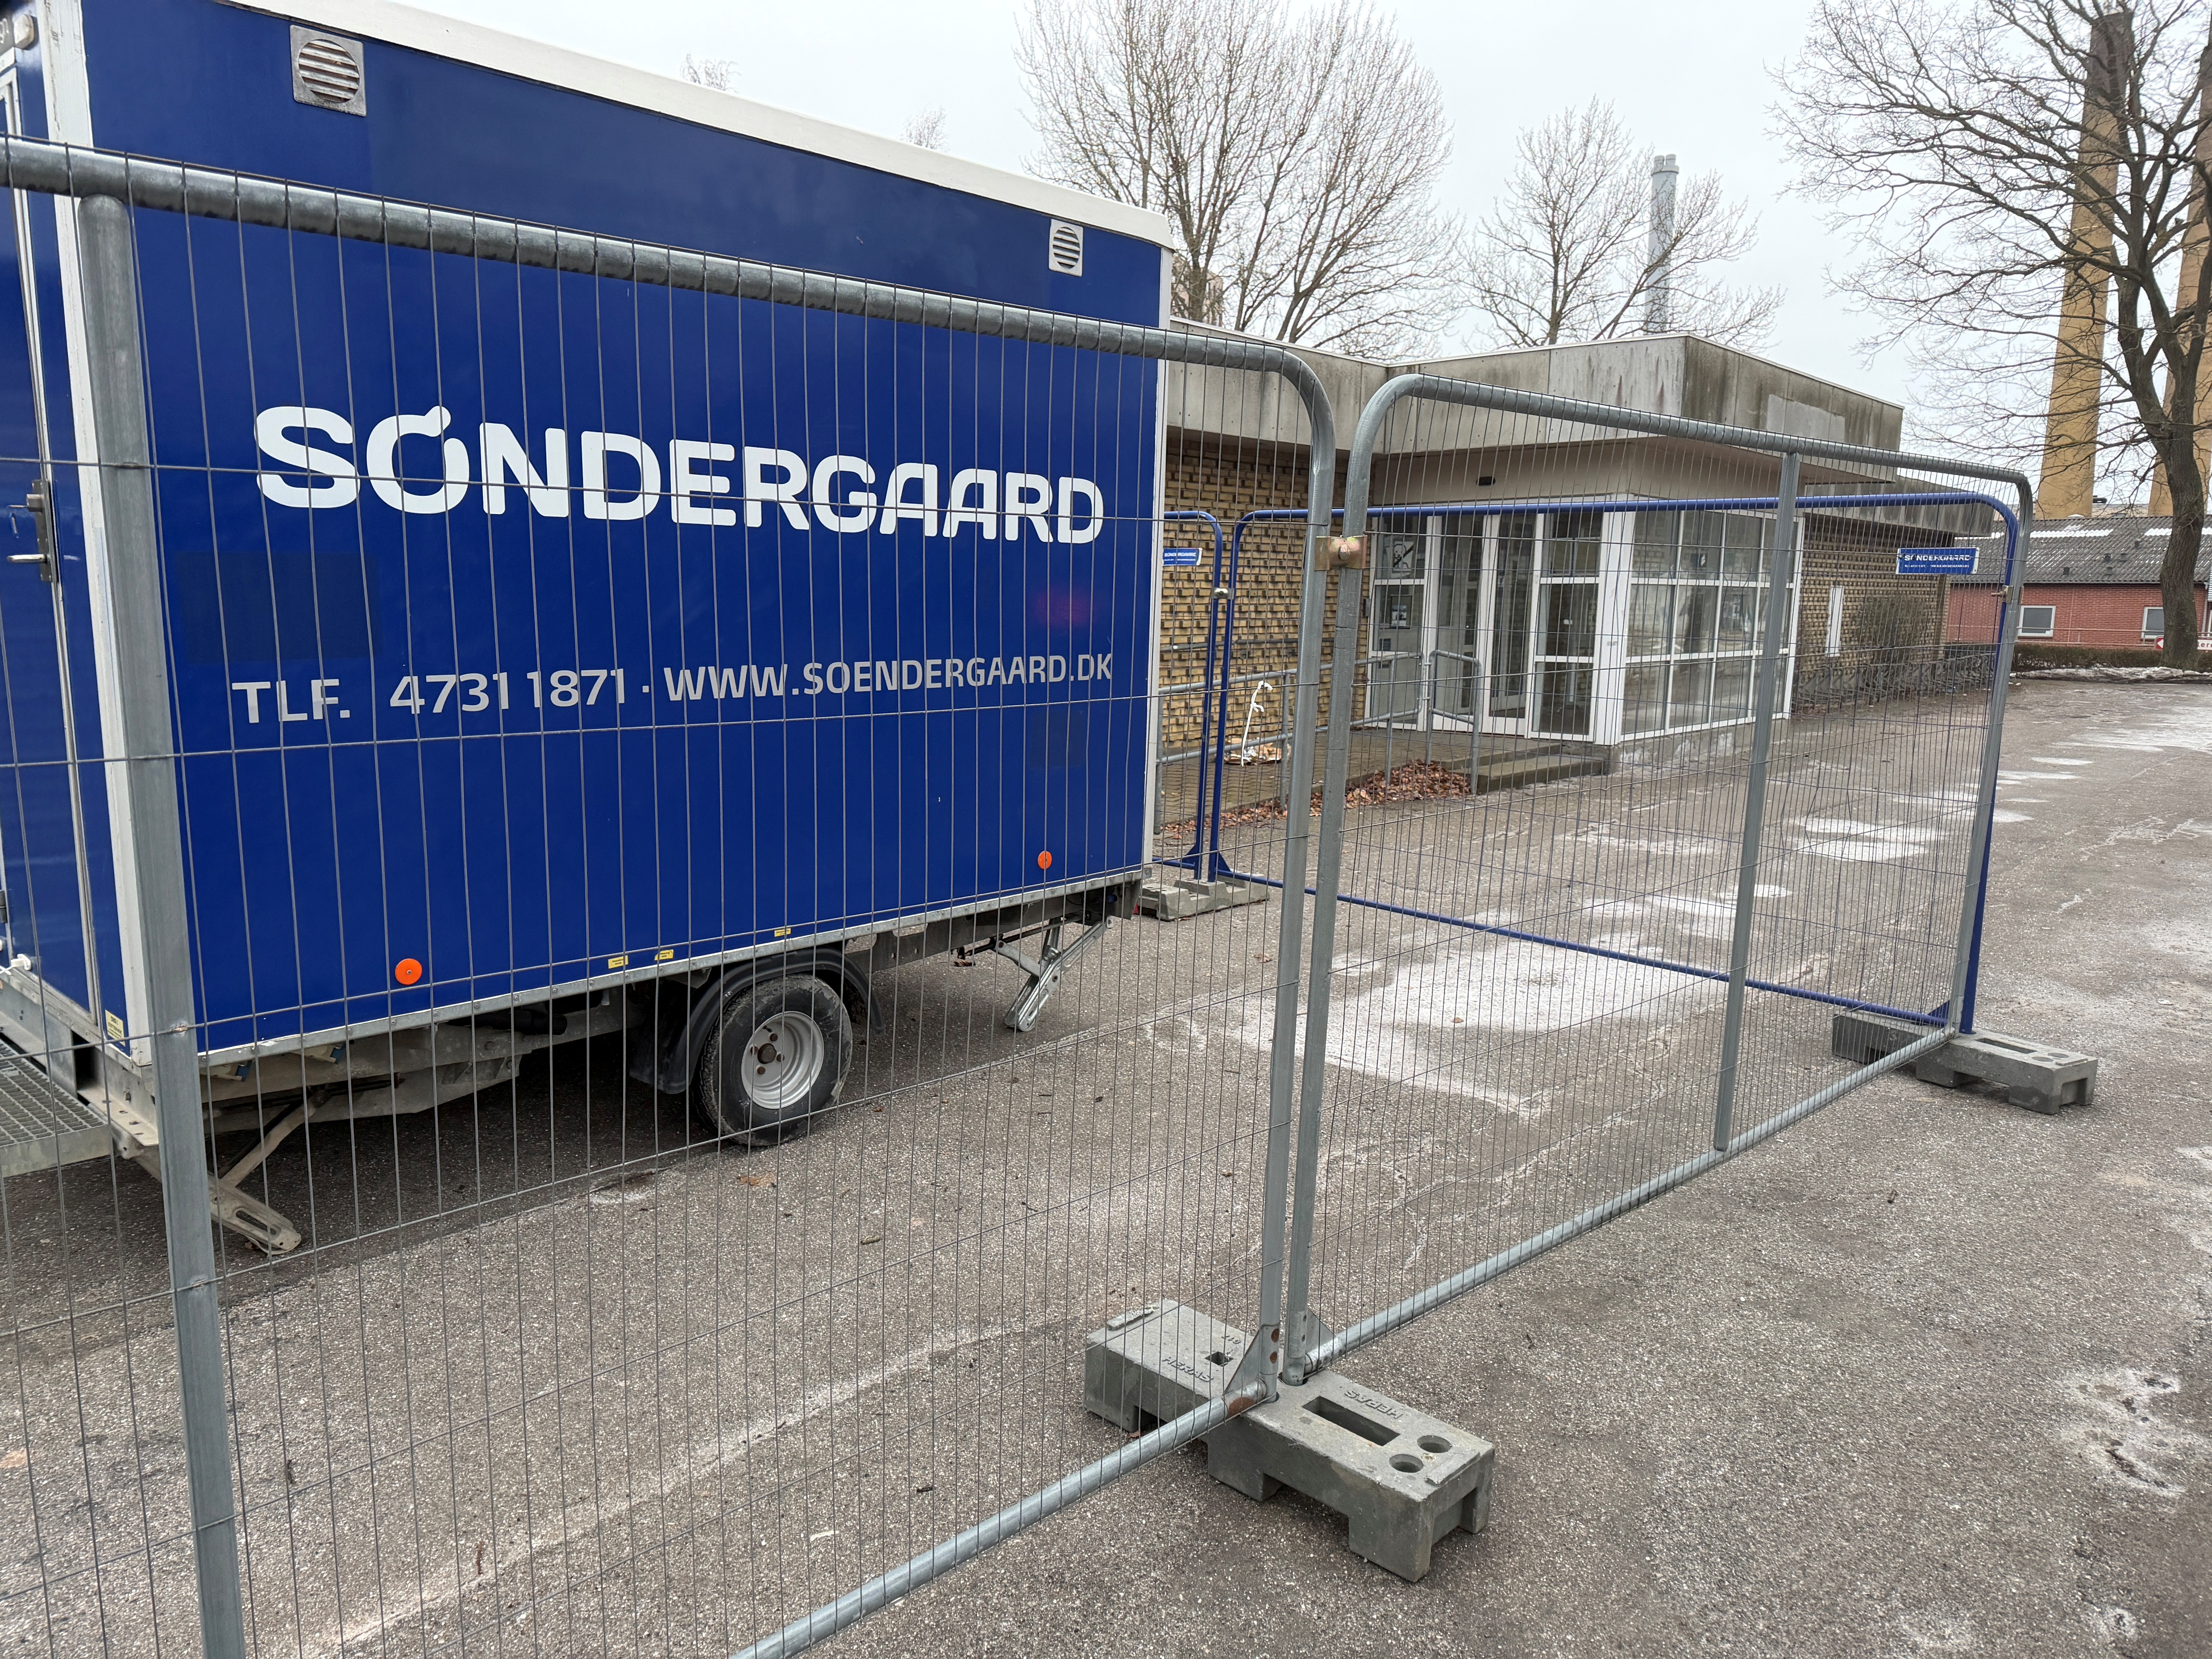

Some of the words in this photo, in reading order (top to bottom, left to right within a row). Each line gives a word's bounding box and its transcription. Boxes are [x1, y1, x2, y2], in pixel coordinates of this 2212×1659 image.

[232, 678, 350, 723] TLF.
[390, 672, 509, 714] 4731
[527, 668, 625, 708] 1871
[664, 653, 1113, 701] WWW.SOENDERGAARD.DK
[1161, 1357, 1214, 1382] HERAS
[1344, 1390, 1403, 1419] HERAS
